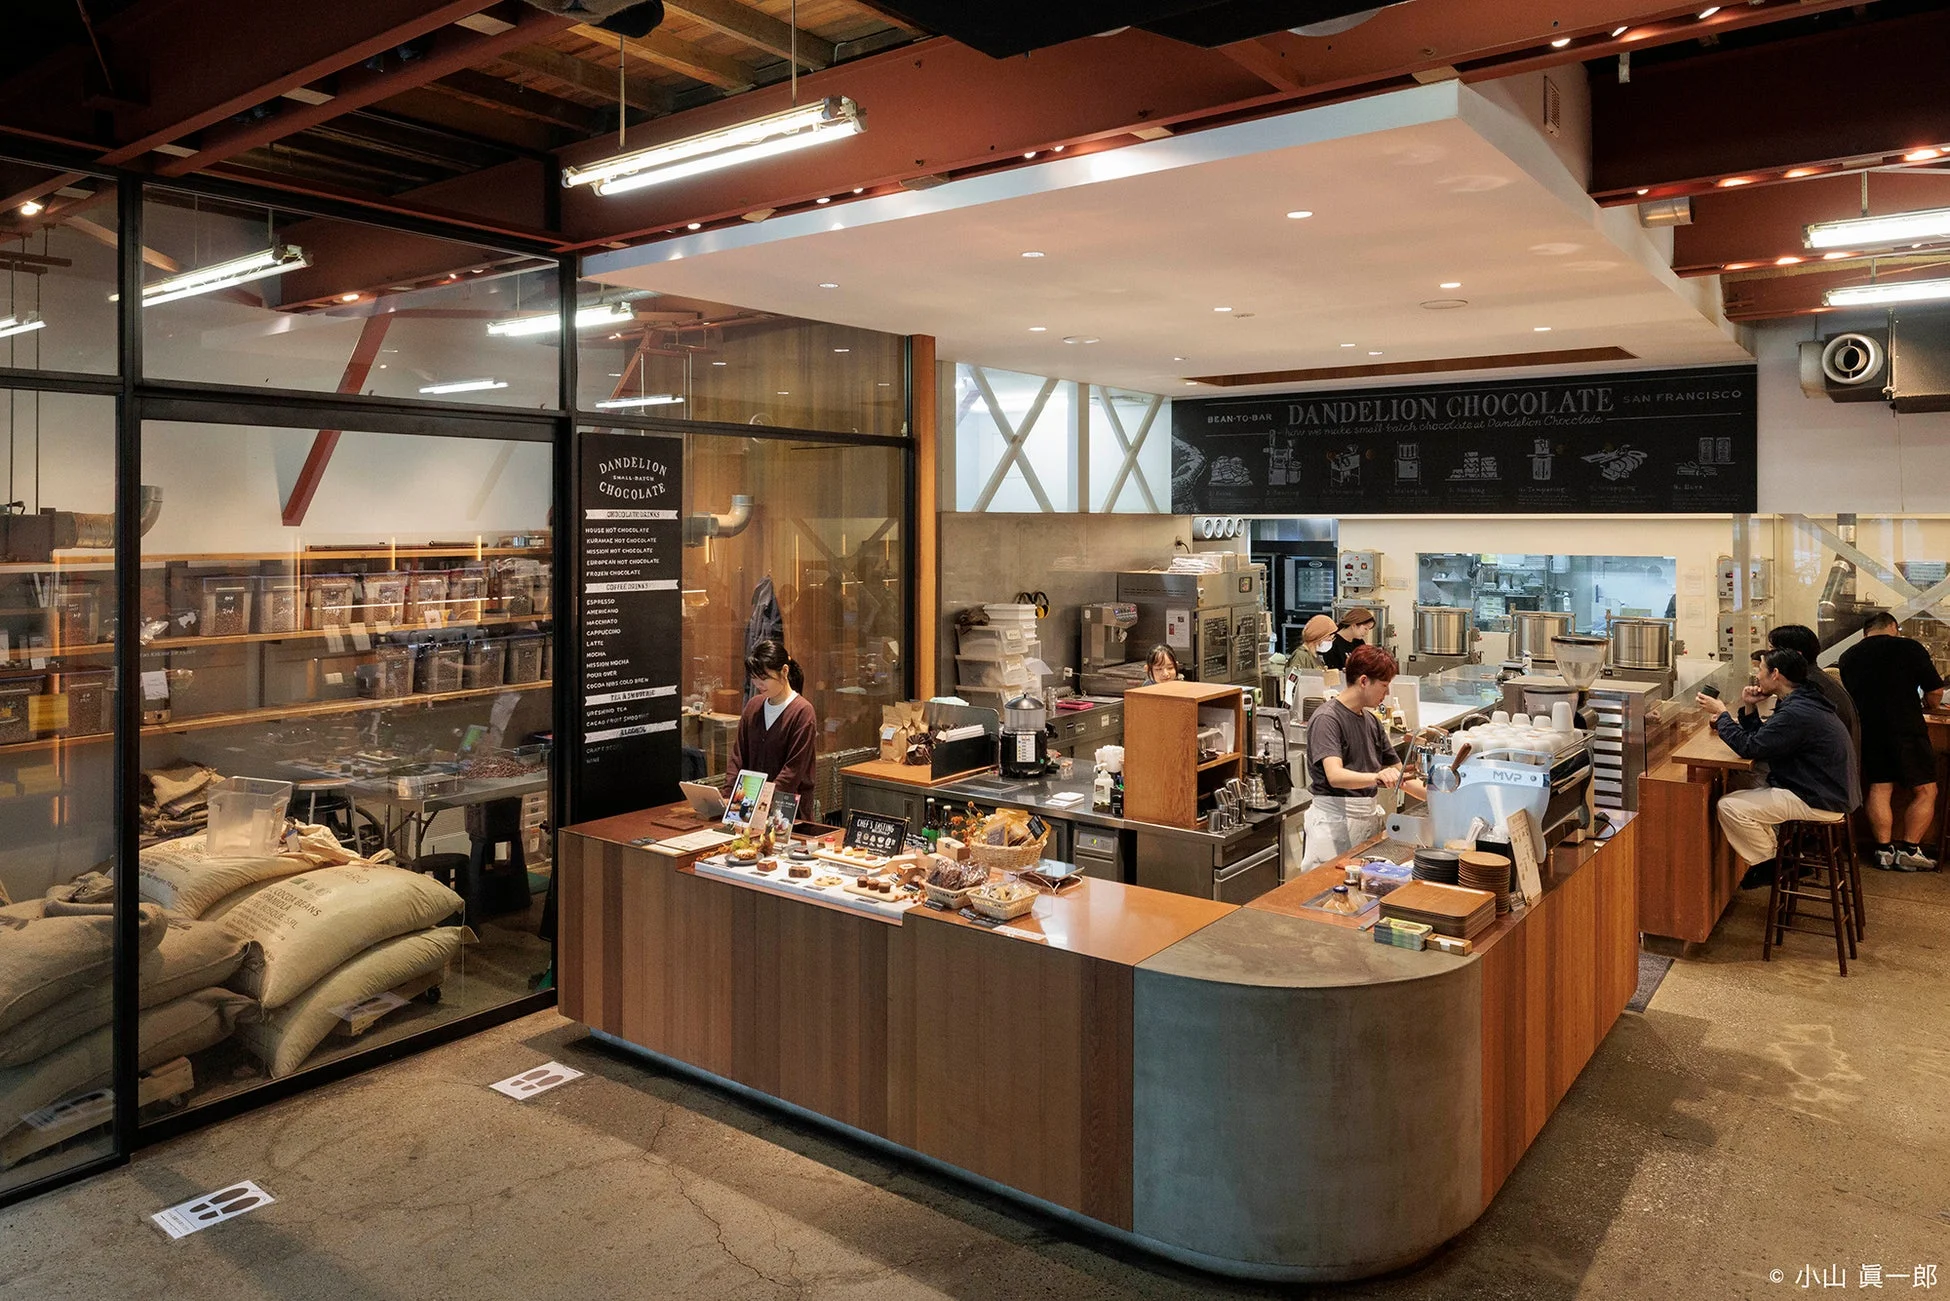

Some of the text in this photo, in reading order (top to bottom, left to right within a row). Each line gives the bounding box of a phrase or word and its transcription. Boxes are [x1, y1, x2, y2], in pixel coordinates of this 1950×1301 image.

[1623, 390, 1742, 404] SAN FRANCISCO
[1288, 387, 1615, 426] DANDELION CHOCOLATE
[1488, 415, 1542, 429] Dandelion
[1544, 414, 1603, 427] Chocolate
[599, 456, 668, 476] DANDELION
[599, 481, 666, 500] CHOCOLATE
[586, 598, 615, 606] ESPRESSO
[586, 618, 618, 626] MACCHIATO
[586, 628, 621, 636] CAPPUCCINO
[610, 658, 630, 666] MOCHA
[586, 682, 605, 690] COCOA
[1492, 770, 1522, 782] MVP
[856, 818, 874, 830] CHEF'S
[874, 821, 895, 834] TASTING
[273, 888, 322, 917] COCOA BEANS
